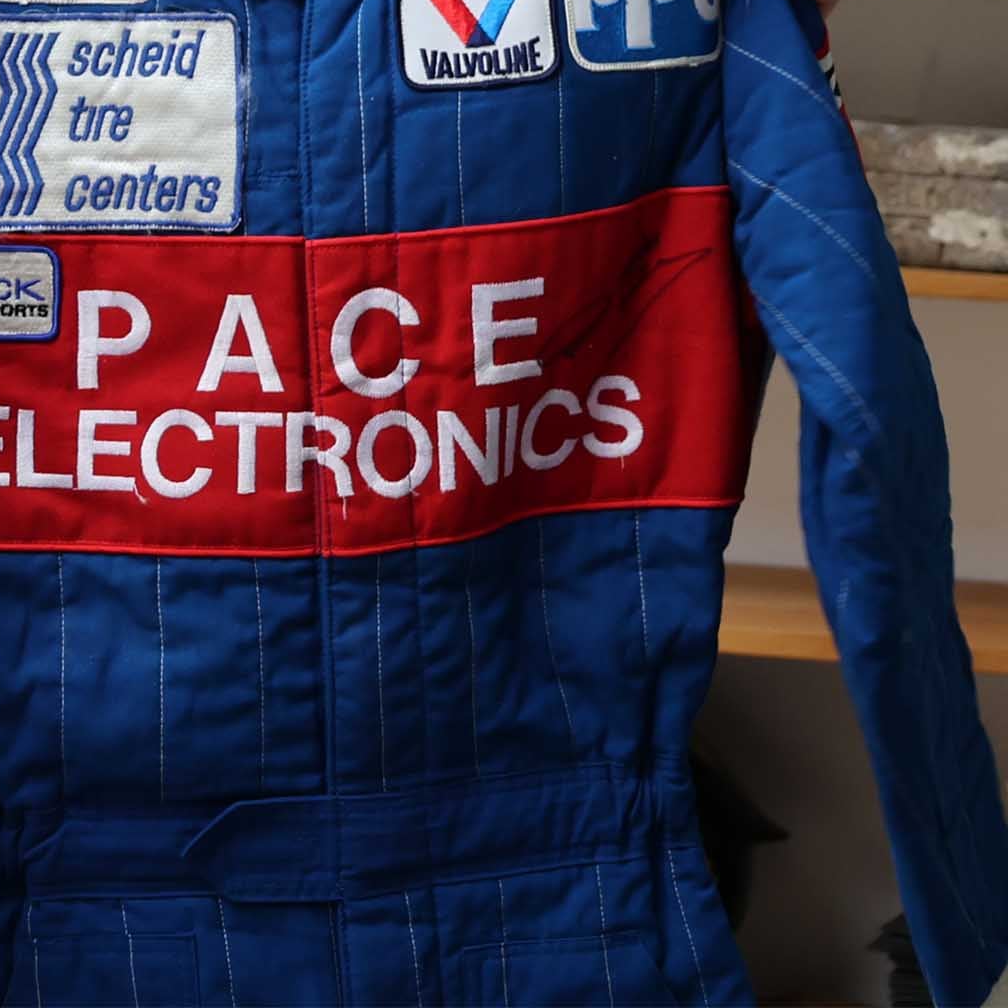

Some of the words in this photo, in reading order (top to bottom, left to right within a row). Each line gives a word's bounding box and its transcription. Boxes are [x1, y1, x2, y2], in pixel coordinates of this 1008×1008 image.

[67, 28, 205, 79] scheid
[419, 37, 544, 80] VALVOLINE
[68, 96, 134, 142] tire
[64, 164, 222, 213] centers
